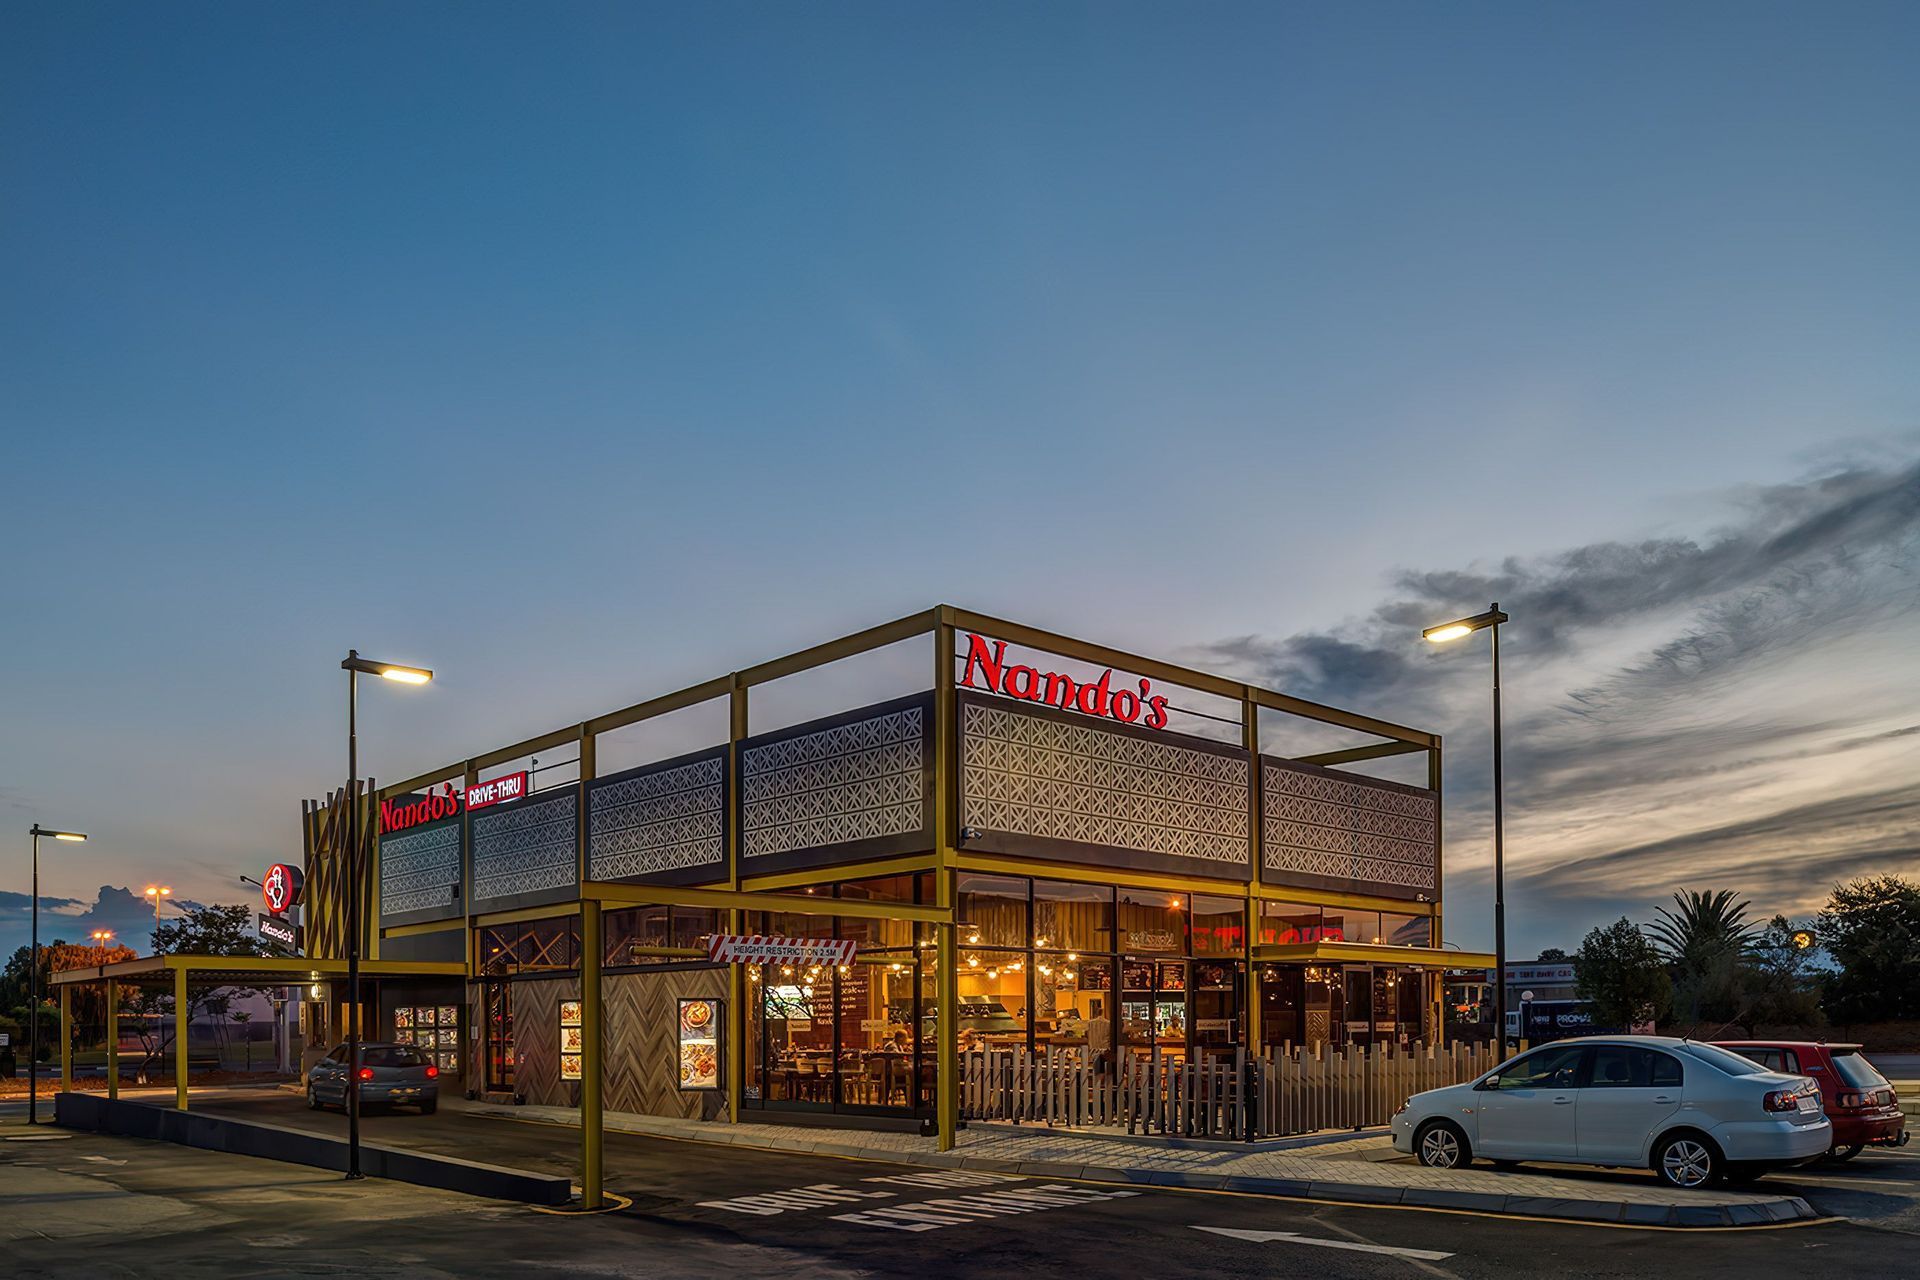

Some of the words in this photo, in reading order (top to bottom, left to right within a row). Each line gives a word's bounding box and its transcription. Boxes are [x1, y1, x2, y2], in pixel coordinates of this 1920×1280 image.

[961, 634, 1169, 730] Nando's
[469, 777, 521, 806] DRIVE-THRU
[379, 782, 460, 834] Nando's
[260, 921, 294, 943] Nando's
[734, 945, 763, 954] HEIGHT
[766, 946, 818, 956] RESTRICTION
[820, 948, 837, 956] 2.5M
[694, 1184, 898, 1216] DRIVE
